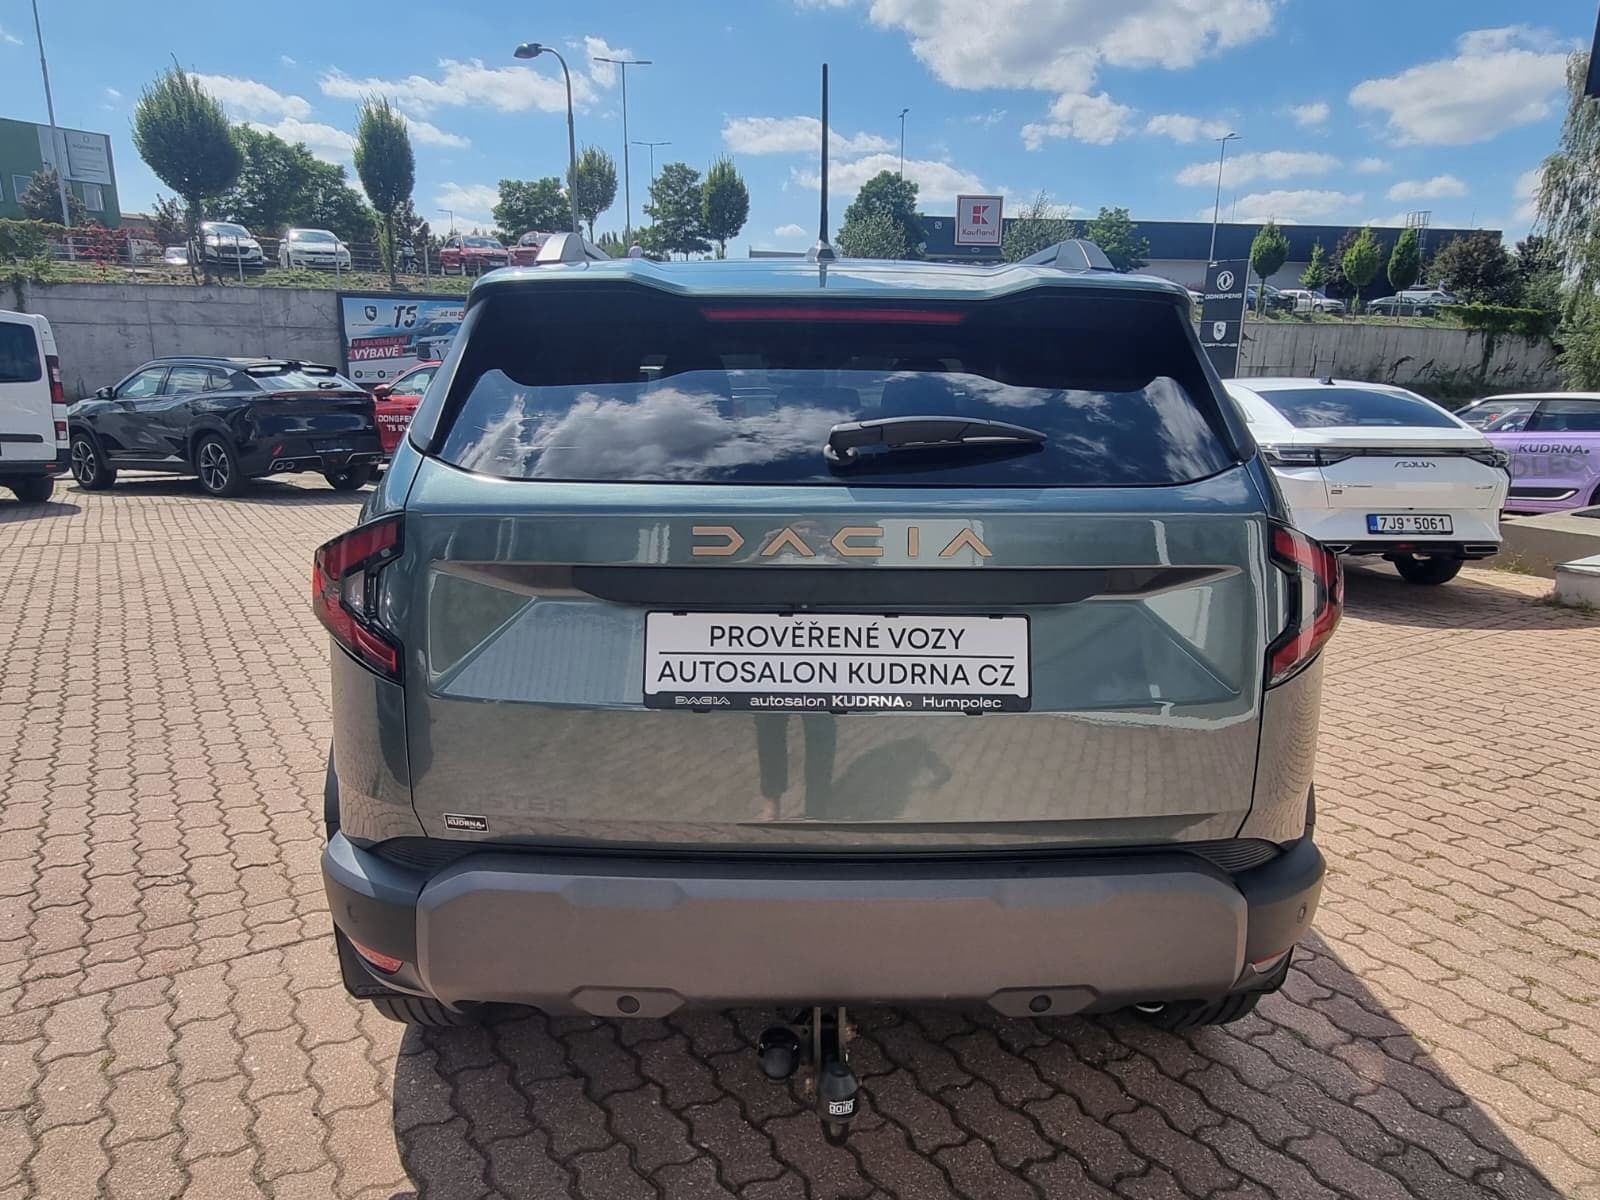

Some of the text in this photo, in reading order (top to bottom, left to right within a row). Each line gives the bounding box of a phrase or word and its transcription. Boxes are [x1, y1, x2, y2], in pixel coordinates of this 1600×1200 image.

[962, 228, 996, 237] Kaufland
[393, 305, 417, 328] T5
[354, 345, 400, 360] VÝBAVĚ
[1379, 517, 1446, 530] 7J9 5061
[692, 526, 993, 557] DACIA
[710, 621, 965, 650] PROVĚŘENÉ VOZY
[657, 660, 1016, 687] AUTOSALON KUDRNA CZ
[674, 696, 730, 705] DACIA
[750, 696, 826, 707] autosalon
[922, 696, 1002, 710] Humpolec
